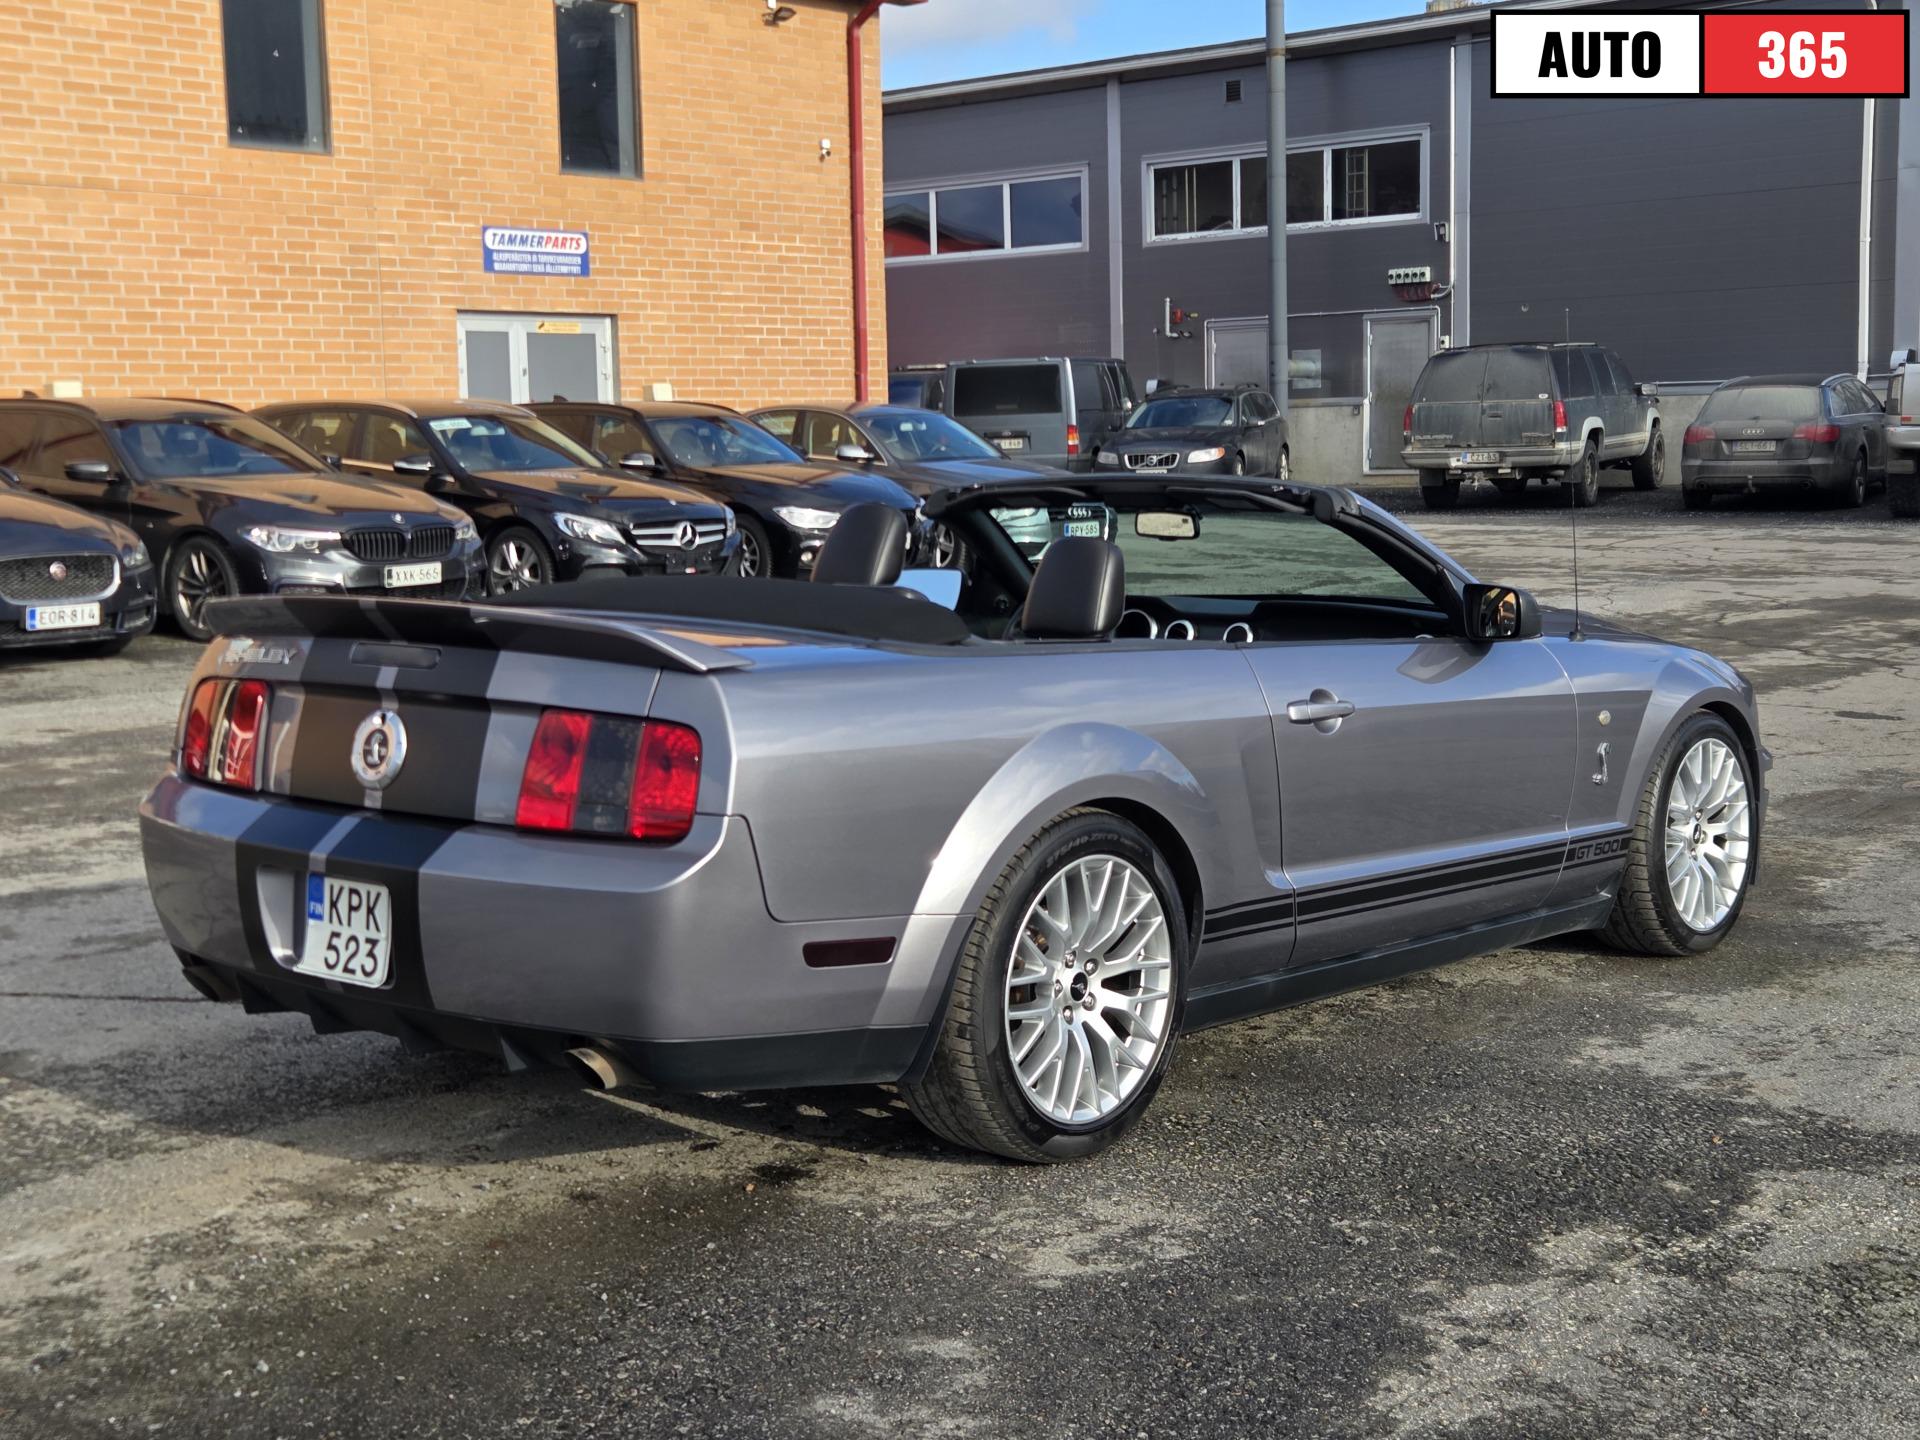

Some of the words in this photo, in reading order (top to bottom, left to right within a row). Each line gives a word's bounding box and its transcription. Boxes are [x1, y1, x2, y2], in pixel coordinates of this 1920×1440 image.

[491, 232, 582, 251] TAMMERPARTS
[328, 883, 382, 933] KPK
[324, 931, 380, 978] 523
